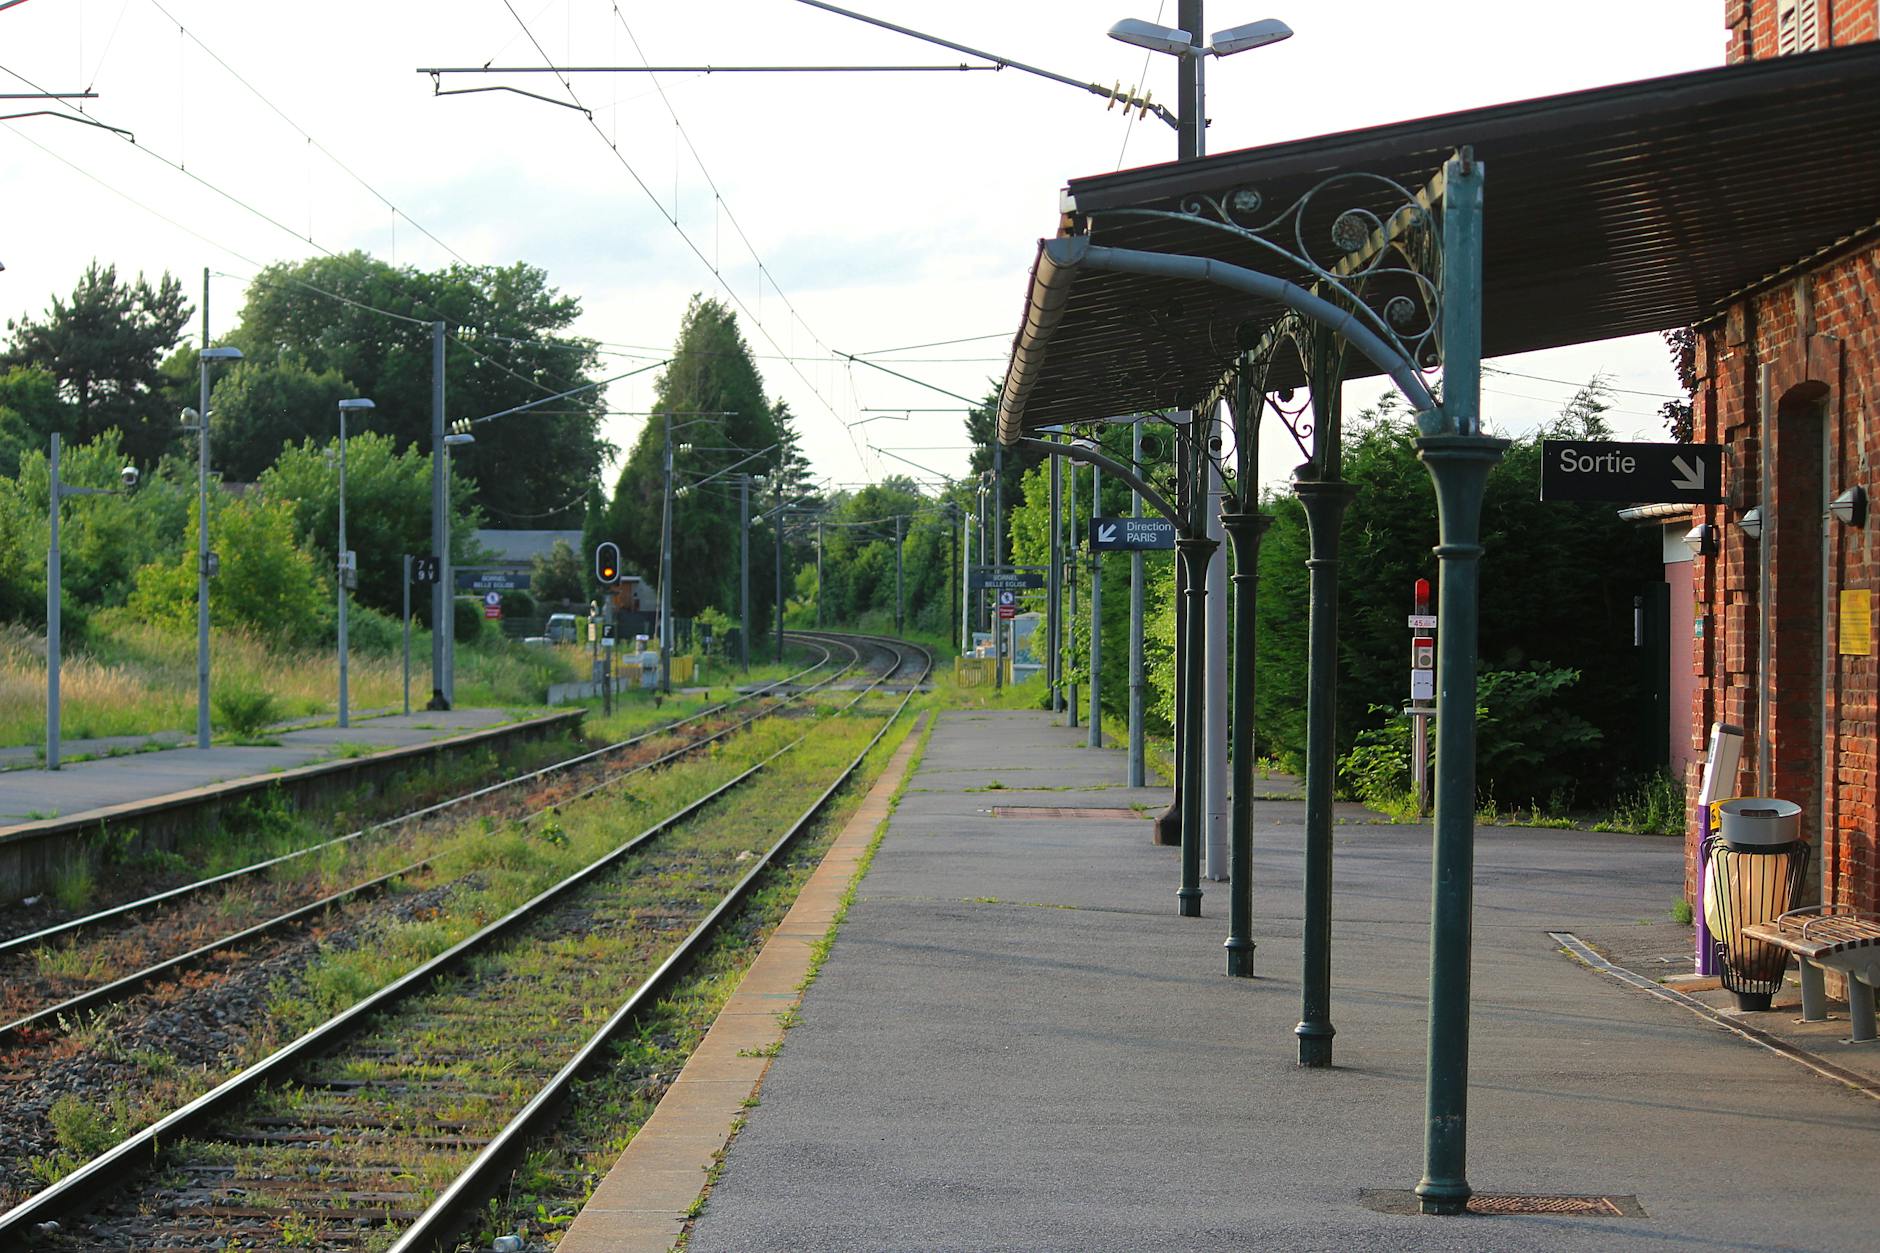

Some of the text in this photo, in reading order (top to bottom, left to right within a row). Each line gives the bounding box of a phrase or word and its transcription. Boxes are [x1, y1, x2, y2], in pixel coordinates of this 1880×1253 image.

[1559, 448, 1636, 474] Sortie
[1126, 521, 1171, 531] Direction
[1126, 532, 1157, 542] PARIS
[417, 560, 425, 570] 7
[417, 570, 425, 580] 9
[604, 626, 612, 636] F
